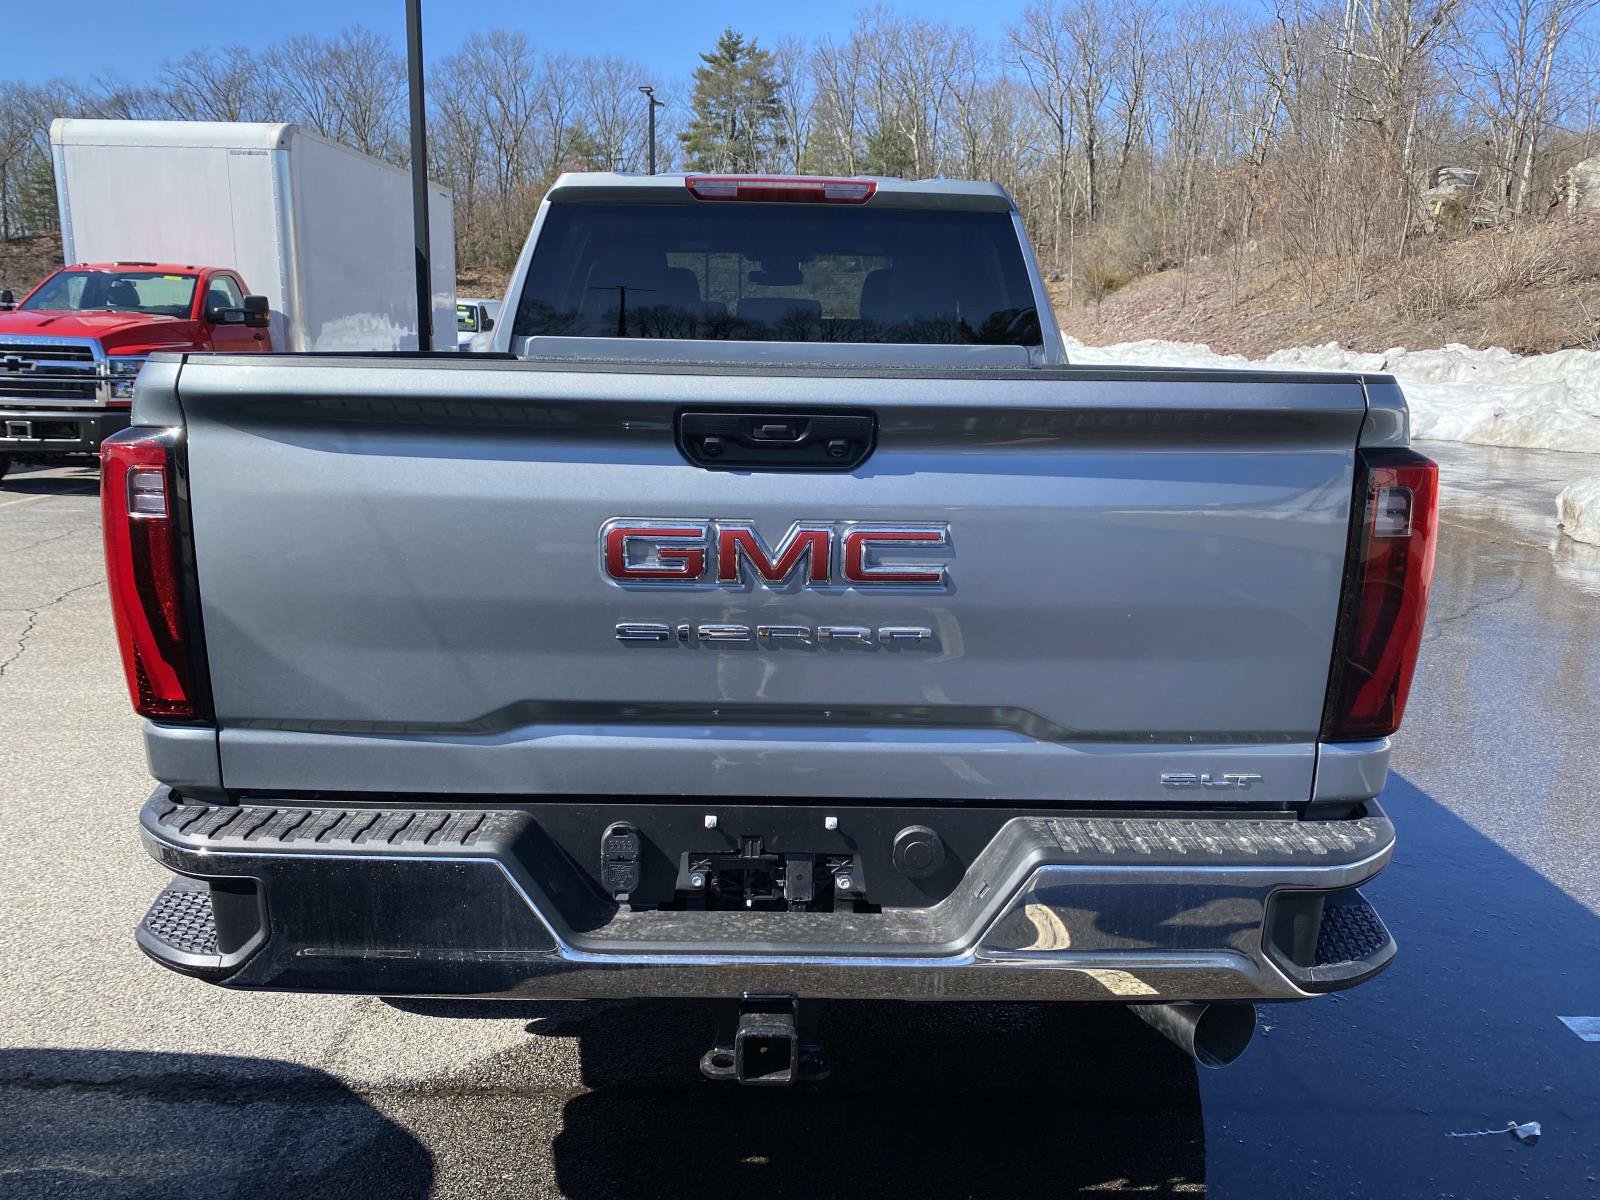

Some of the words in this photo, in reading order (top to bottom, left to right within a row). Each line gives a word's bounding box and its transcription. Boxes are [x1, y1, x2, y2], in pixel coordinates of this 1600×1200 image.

[602, 518, 950, 591] GMC
[615, 623, 932, 646] SIERRA
[1160, 772, 1262, 787] SLT
